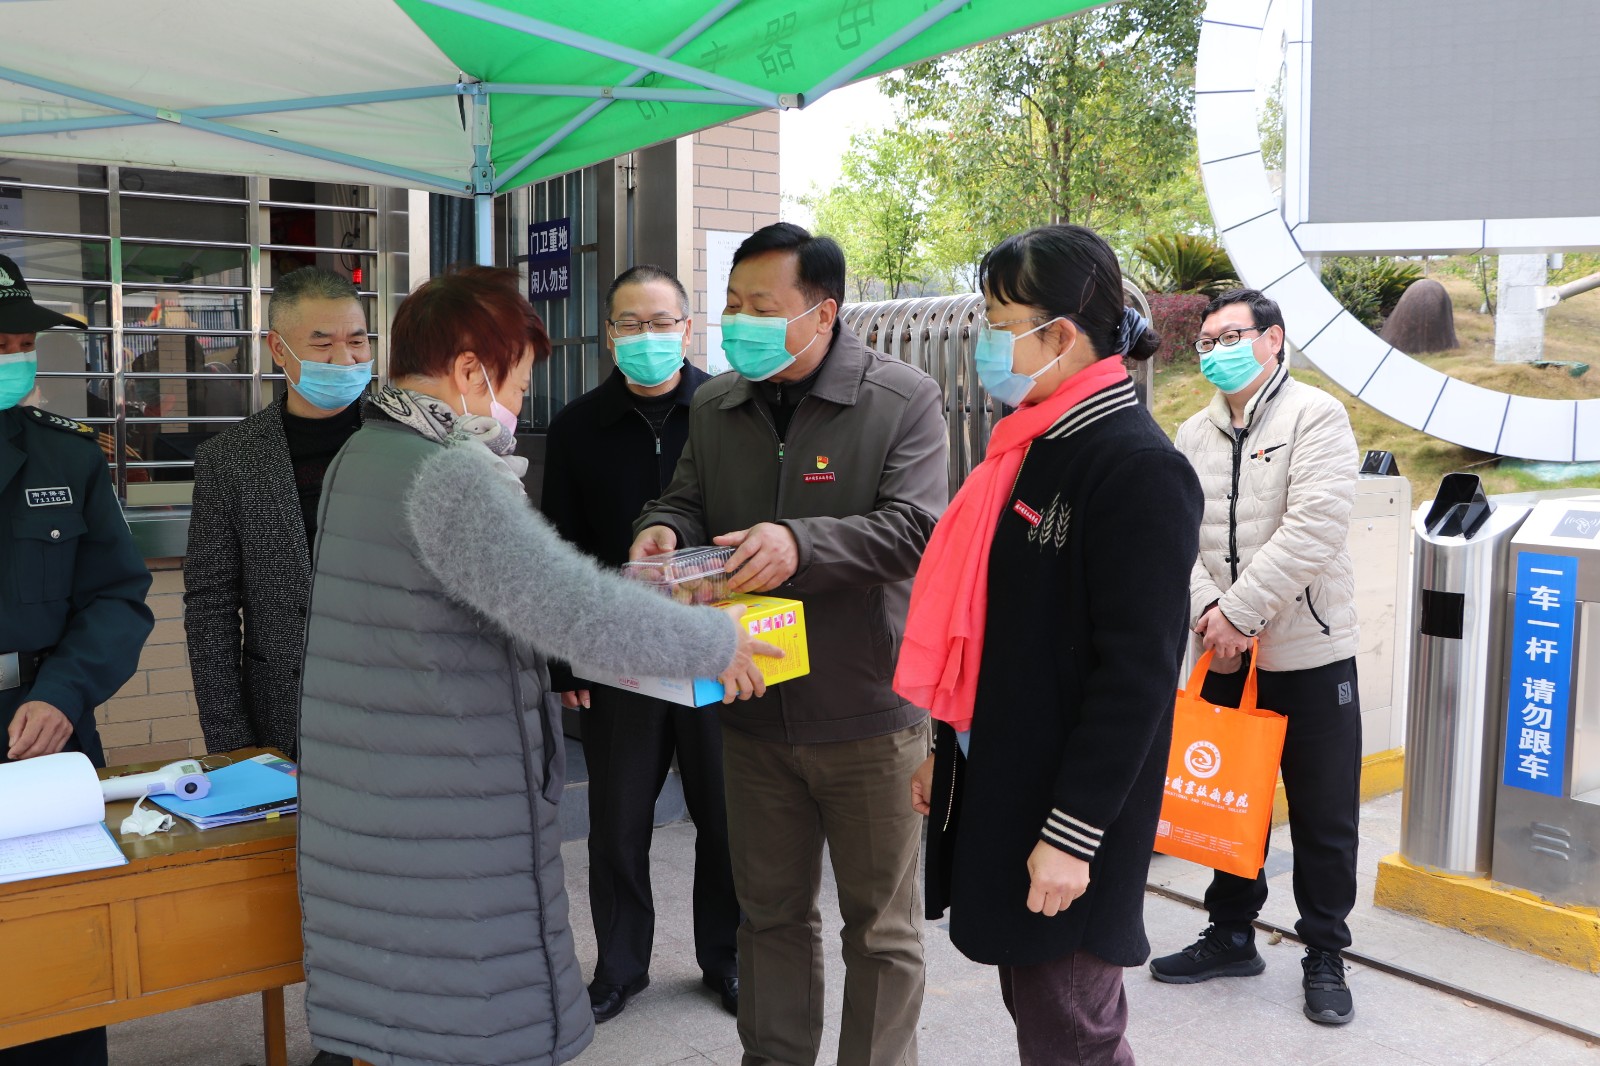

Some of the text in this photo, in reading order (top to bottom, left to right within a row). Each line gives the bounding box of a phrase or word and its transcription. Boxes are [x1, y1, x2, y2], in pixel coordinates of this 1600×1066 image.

[530, 226, 568, 255] 门卫重地
[531, 266, 568, 294] 闲人勿进
[1517, 567, 1564, 780] 一车一杆 请勿跟车
